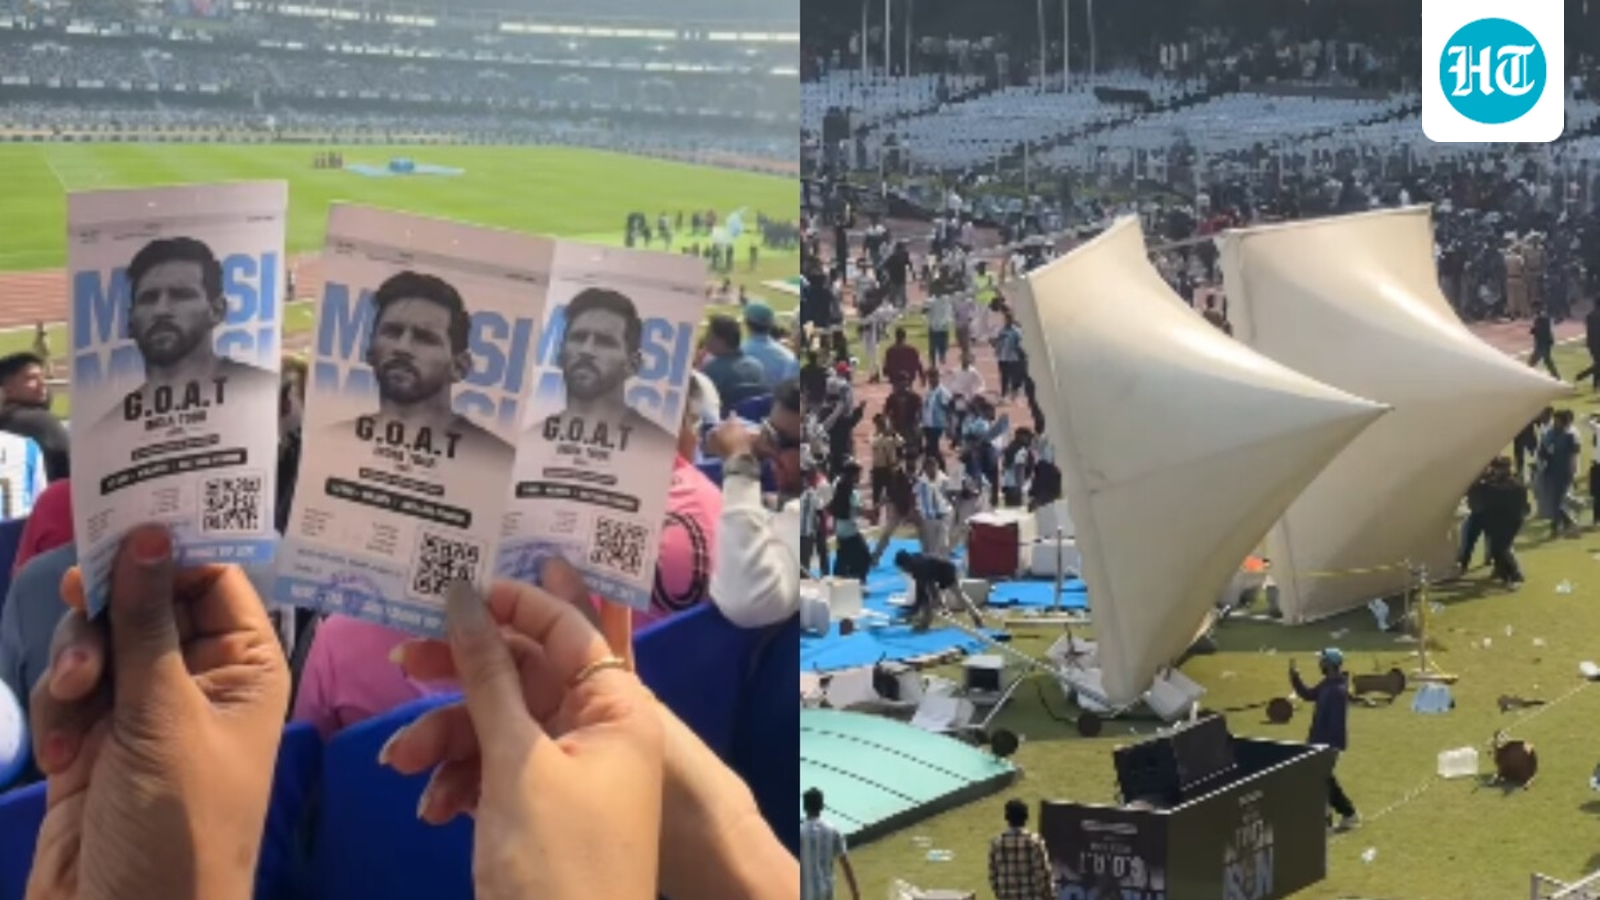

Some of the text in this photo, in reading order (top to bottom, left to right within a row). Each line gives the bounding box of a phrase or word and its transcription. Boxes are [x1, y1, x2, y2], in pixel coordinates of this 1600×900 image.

[74, 250, 278, 349] MSI
[318, 281, 533, 393] MSI
[124, 376, 227, 421] G.O.A.T
[356, 416, 461, 458] G.O.A.T
[543, 416, 633, 451] G.O.A.T
